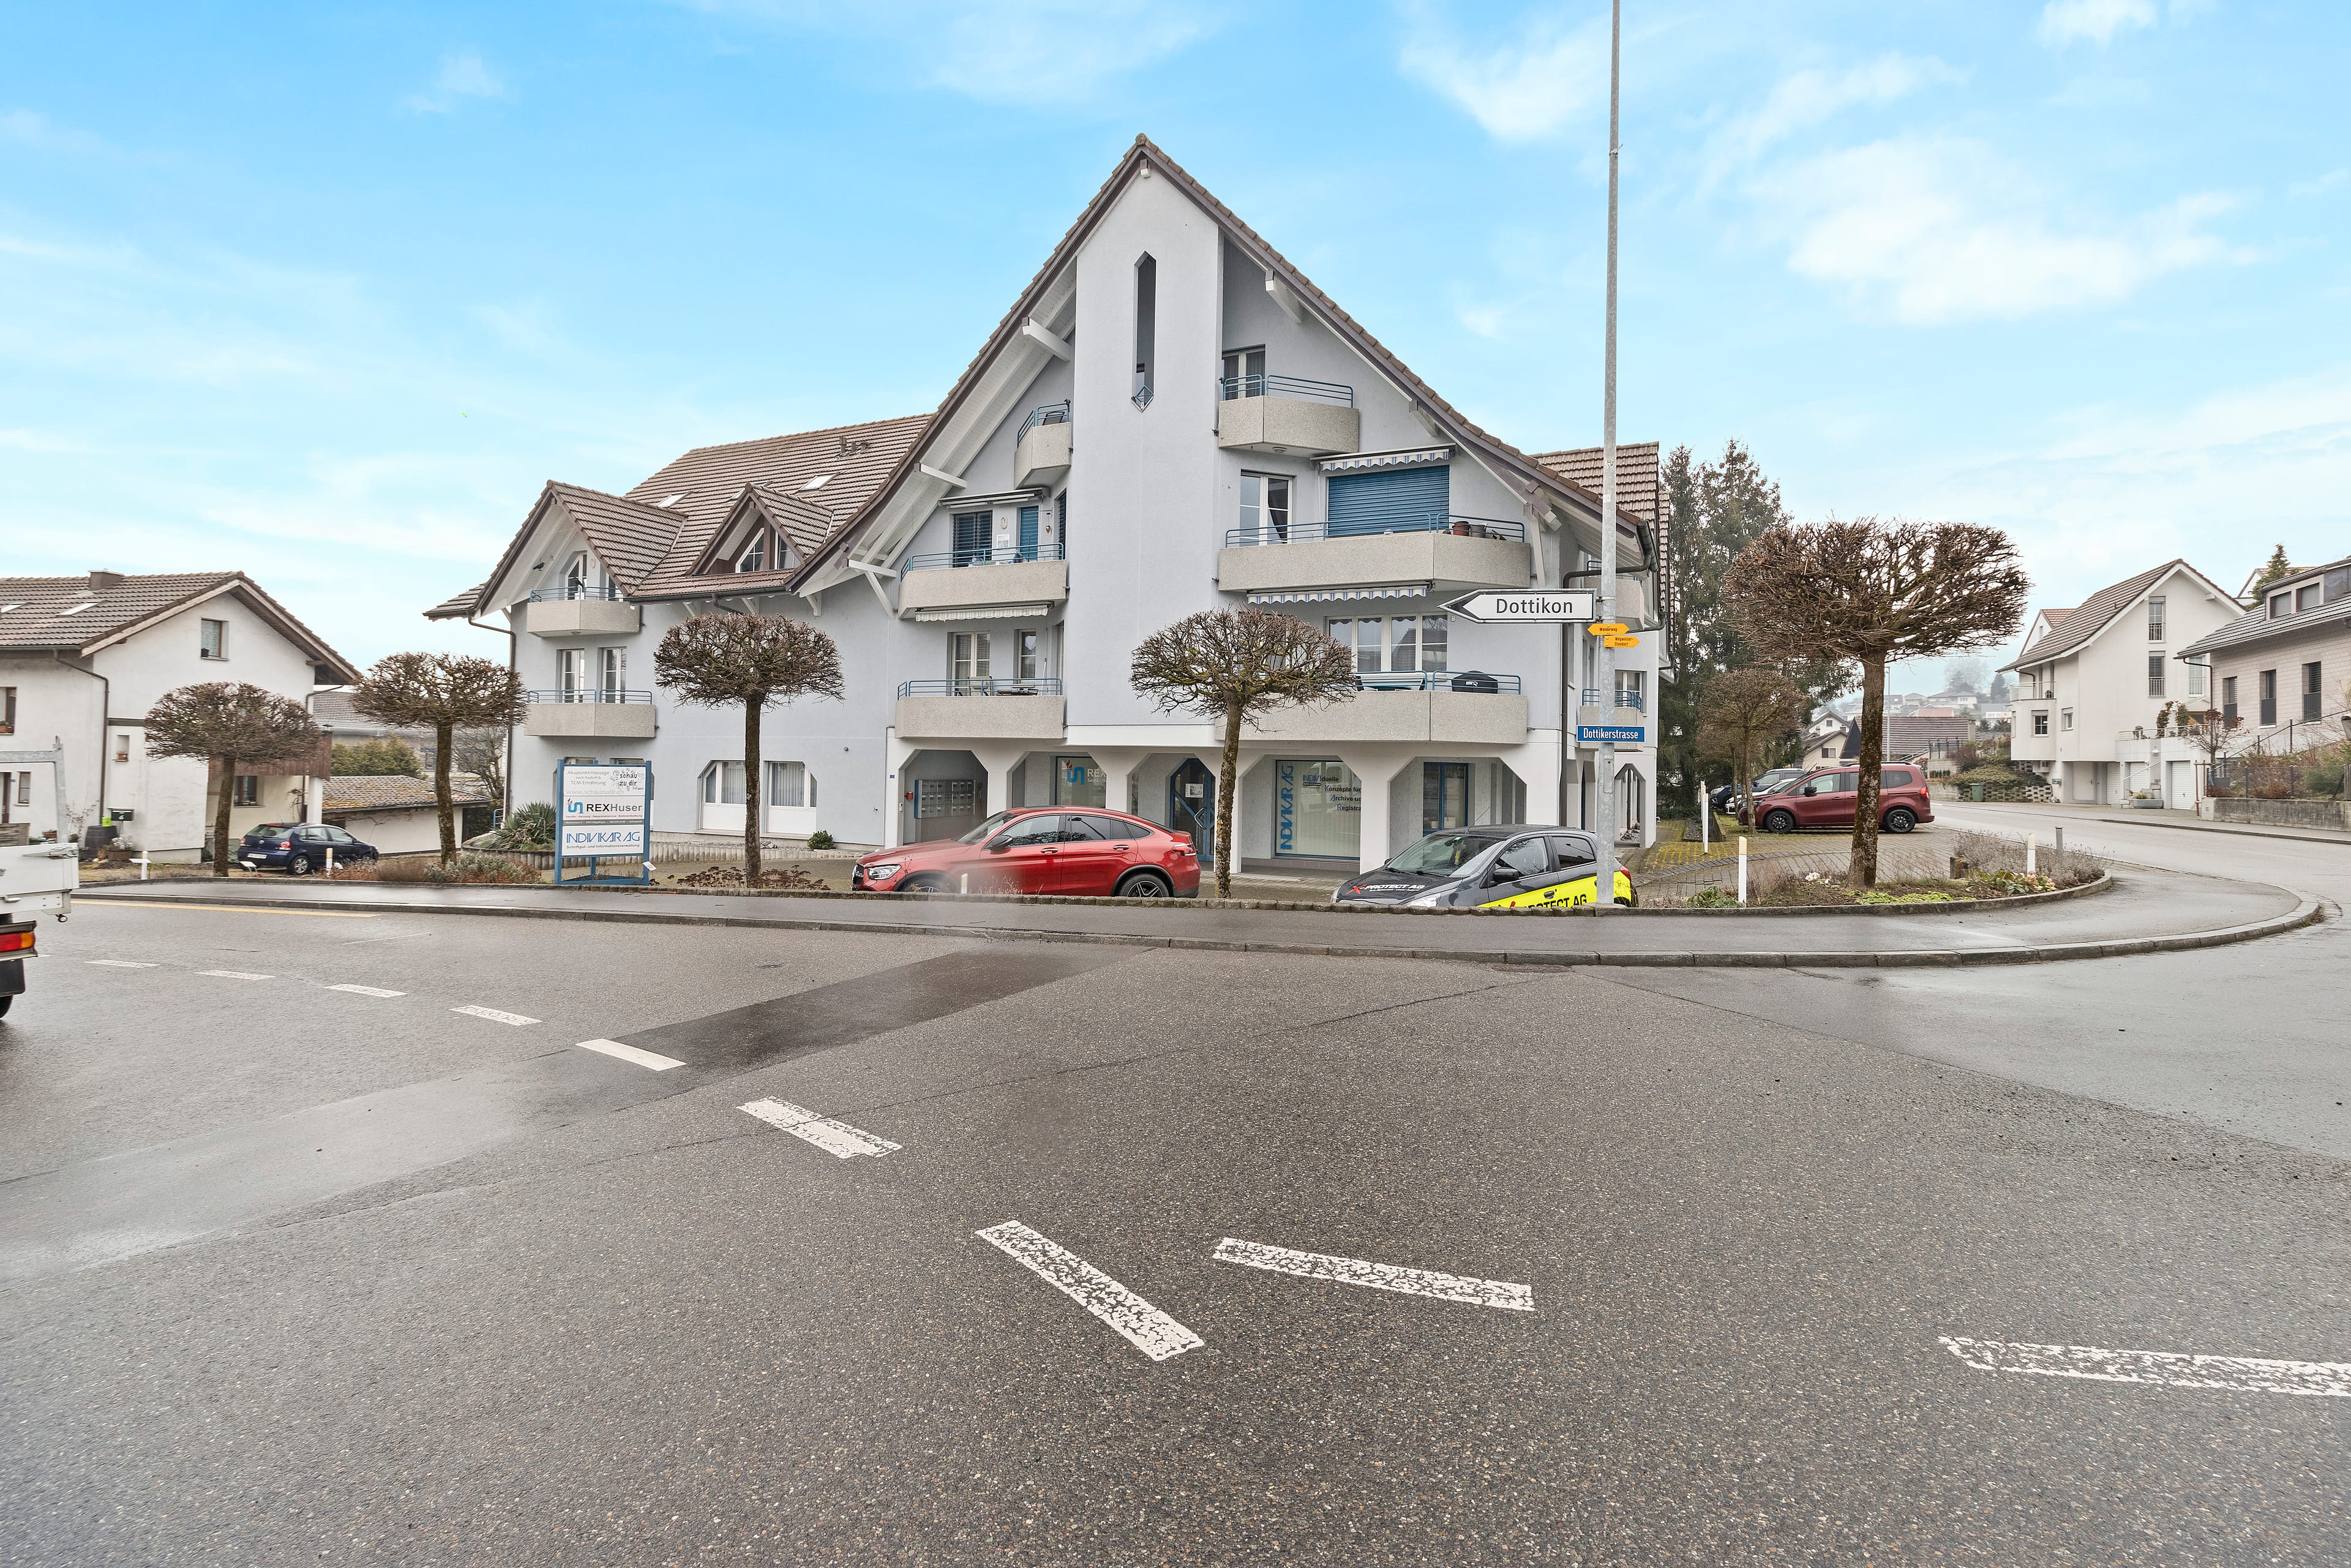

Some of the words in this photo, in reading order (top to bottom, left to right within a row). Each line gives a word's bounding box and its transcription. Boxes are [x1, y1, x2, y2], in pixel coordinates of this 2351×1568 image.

[1496, 597, 1573, 613] Dottikon
[1583, 727, 1638, 739] Dottikerstrasse
[1281, 765, 1293, 786] AG
[587, 803, 642, 812] REXHuser
[566, 832, 621, 843] INDIVIKAR
[623, 831, 640, 842] AG
[1572, 894, 1588, 907] AG
